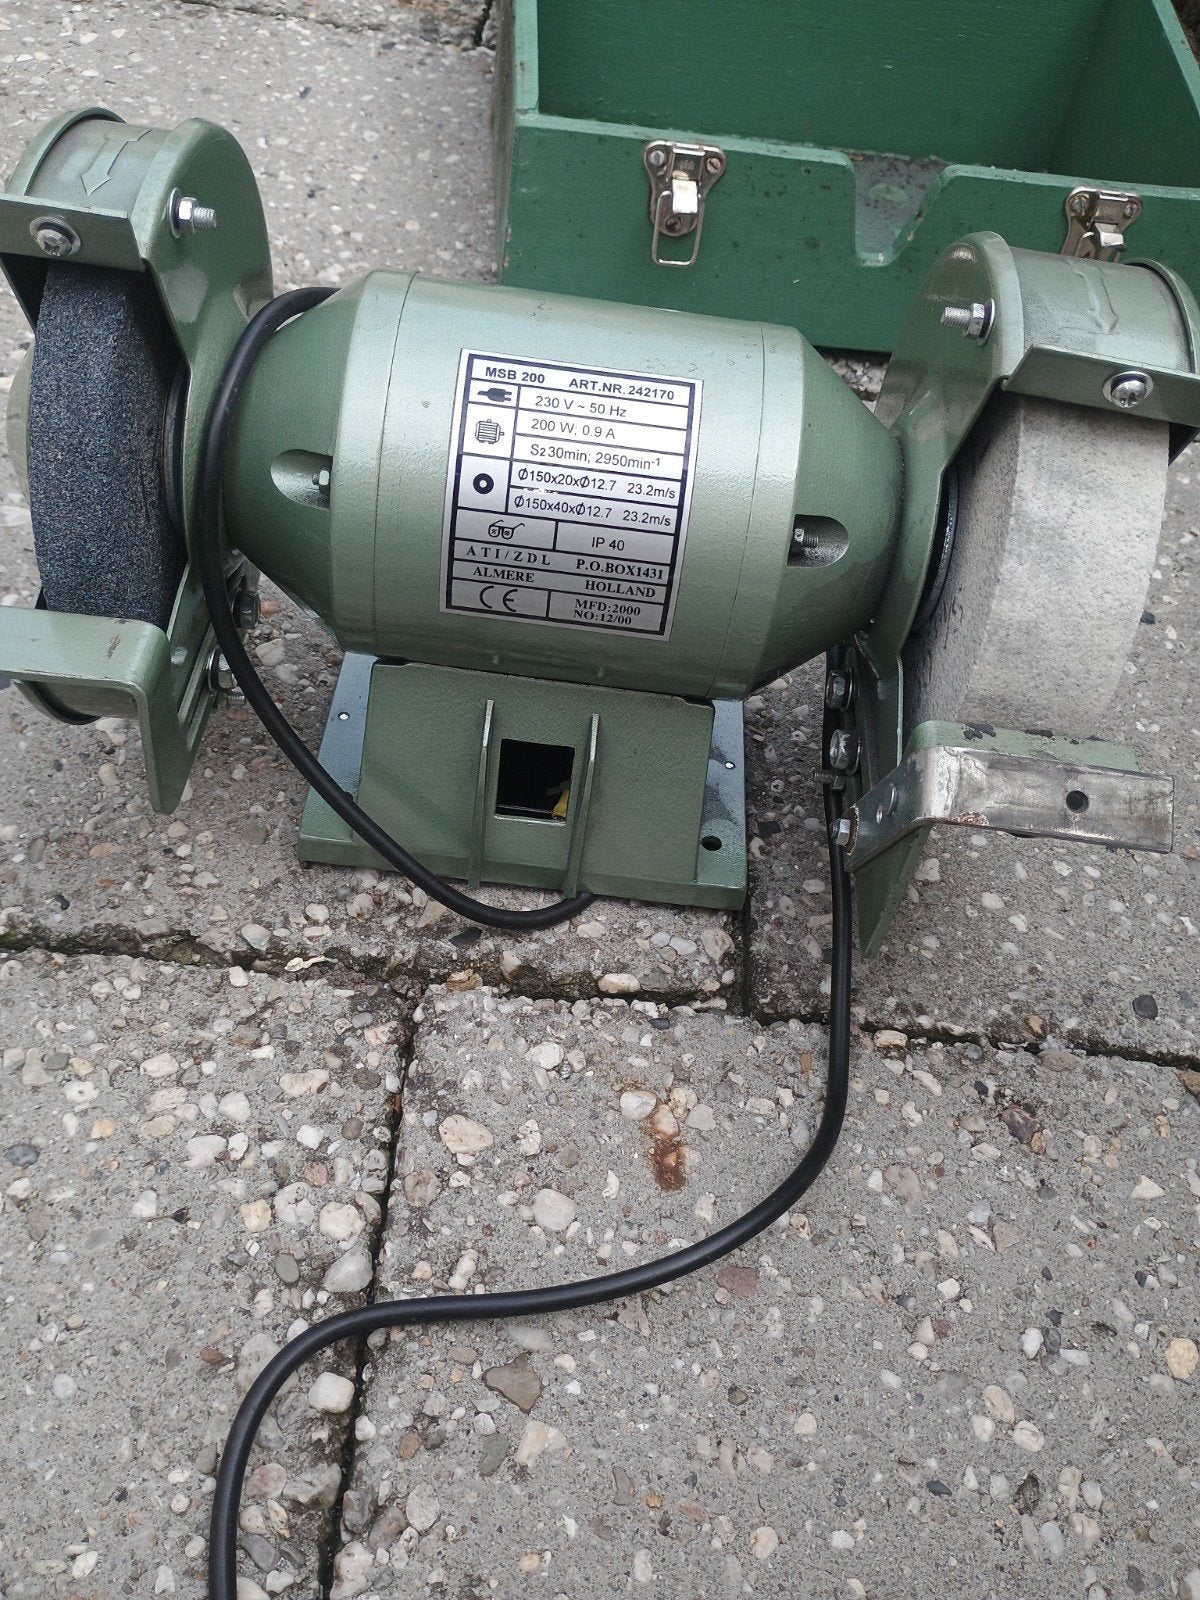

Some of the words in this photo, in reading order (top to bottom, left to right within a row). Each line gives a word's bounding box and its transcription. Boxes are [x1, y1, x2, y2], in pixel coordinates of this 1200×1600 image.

[485, 367, 517, 380] MSB
[521, 372, 545, 384] 200
[535, 396, 560, 408] 230
[564, 398, 574, 410] V
[589, 402, 605, 414] 50
[610, 405, 627, 417] Hz
[531, 418, 556, 431] 200
[582, 425, 602, 438] 0.9
[605, 428, 615, 439] A
[627, 482, 676, 499] 23.2m/s
[623, 510, 671, 526] 23.2m/s
[591, 536, 605, 548] IP
[609, 539, 625, 551] 40
[473, 566, 535, 583] ALMERE
[585, 580, 656, 598] HOLLAND
[575, 599, 641, 617] MFD:2000
[573, 609, 632, 626] NO:12/00
